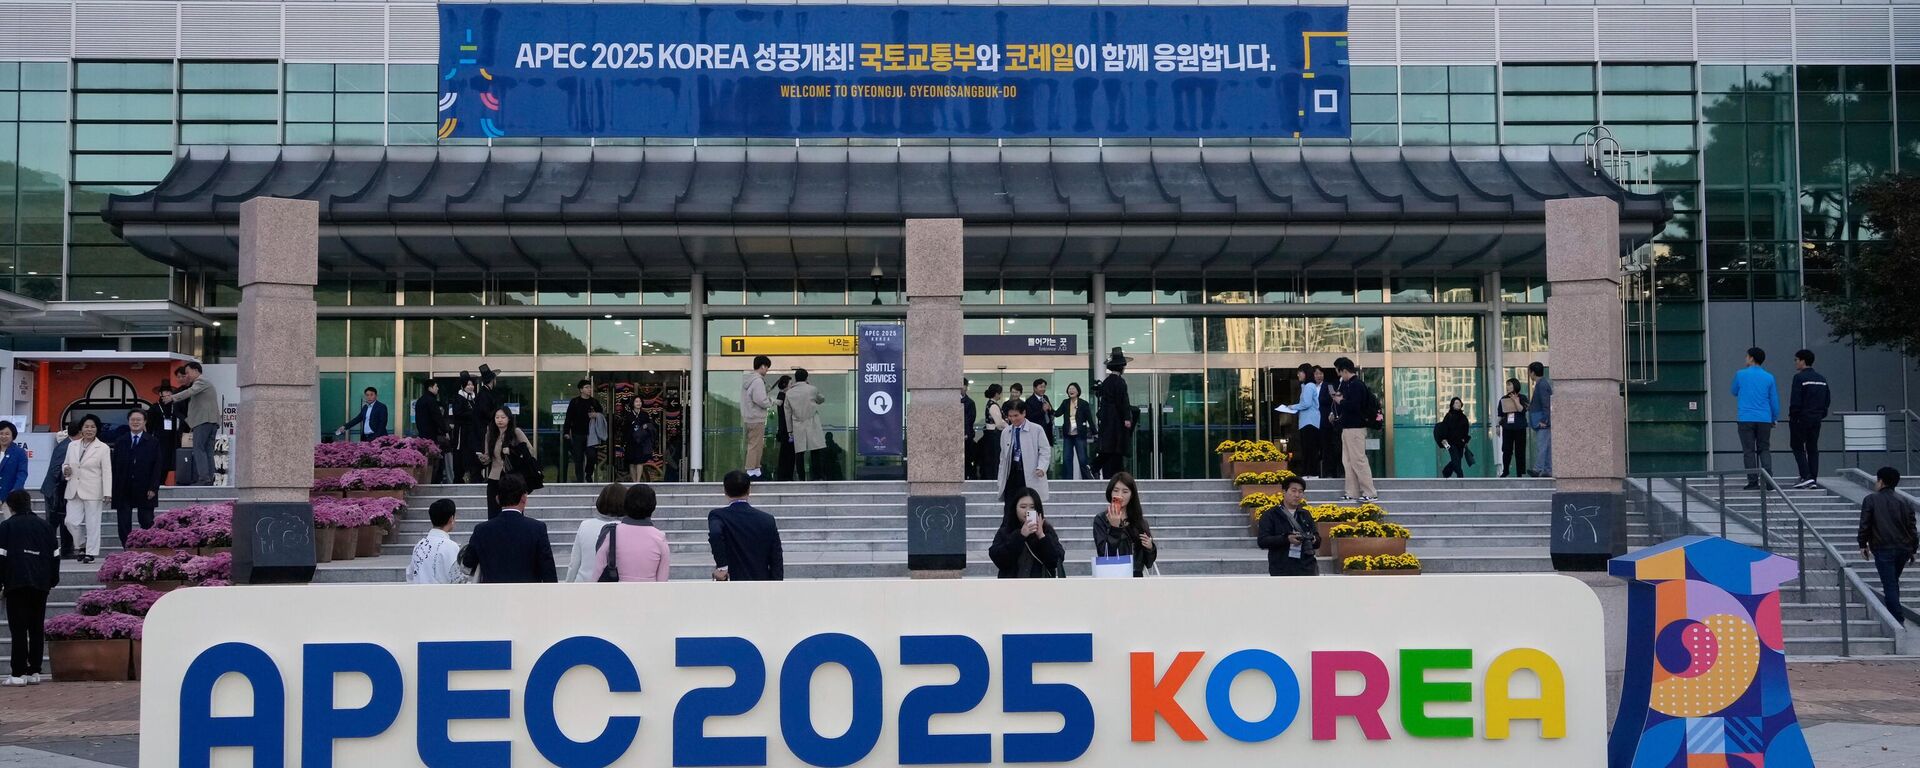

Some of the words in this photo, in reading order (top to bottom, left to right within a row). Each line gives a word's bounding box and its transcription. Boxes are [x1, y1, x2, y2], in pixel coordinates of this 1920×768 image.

[515, 43, 587, 69] APEC
[592, 43, 652, 69] 2025
[658, 43, 749, 69] KOREA
[753, 43, 854, 72] 성공개최!
[859, 43, 1000, 72] 국토교통부와
[1005, 43, 1097, 72] 코레일이
[1101, 43, 1148, 72] 함께
[1153, 43, 1276, 72] 응원합니다.
[780, 85, 831, 98] WELCOME
[834, 85, 848, 98] TO
[910, 85, 1017, 98] GYEONGSANGBUK-DO
[829, 338, 850, 347] 나오는
[866, 363, 895, 372] SHUTTLE
[864, 373, 897, 383] SERVICES
[178, 636, 642, 768] APEC
[673, 633, 1096, 768] 2025
[1130, 647, 1567, 743] KOREA
